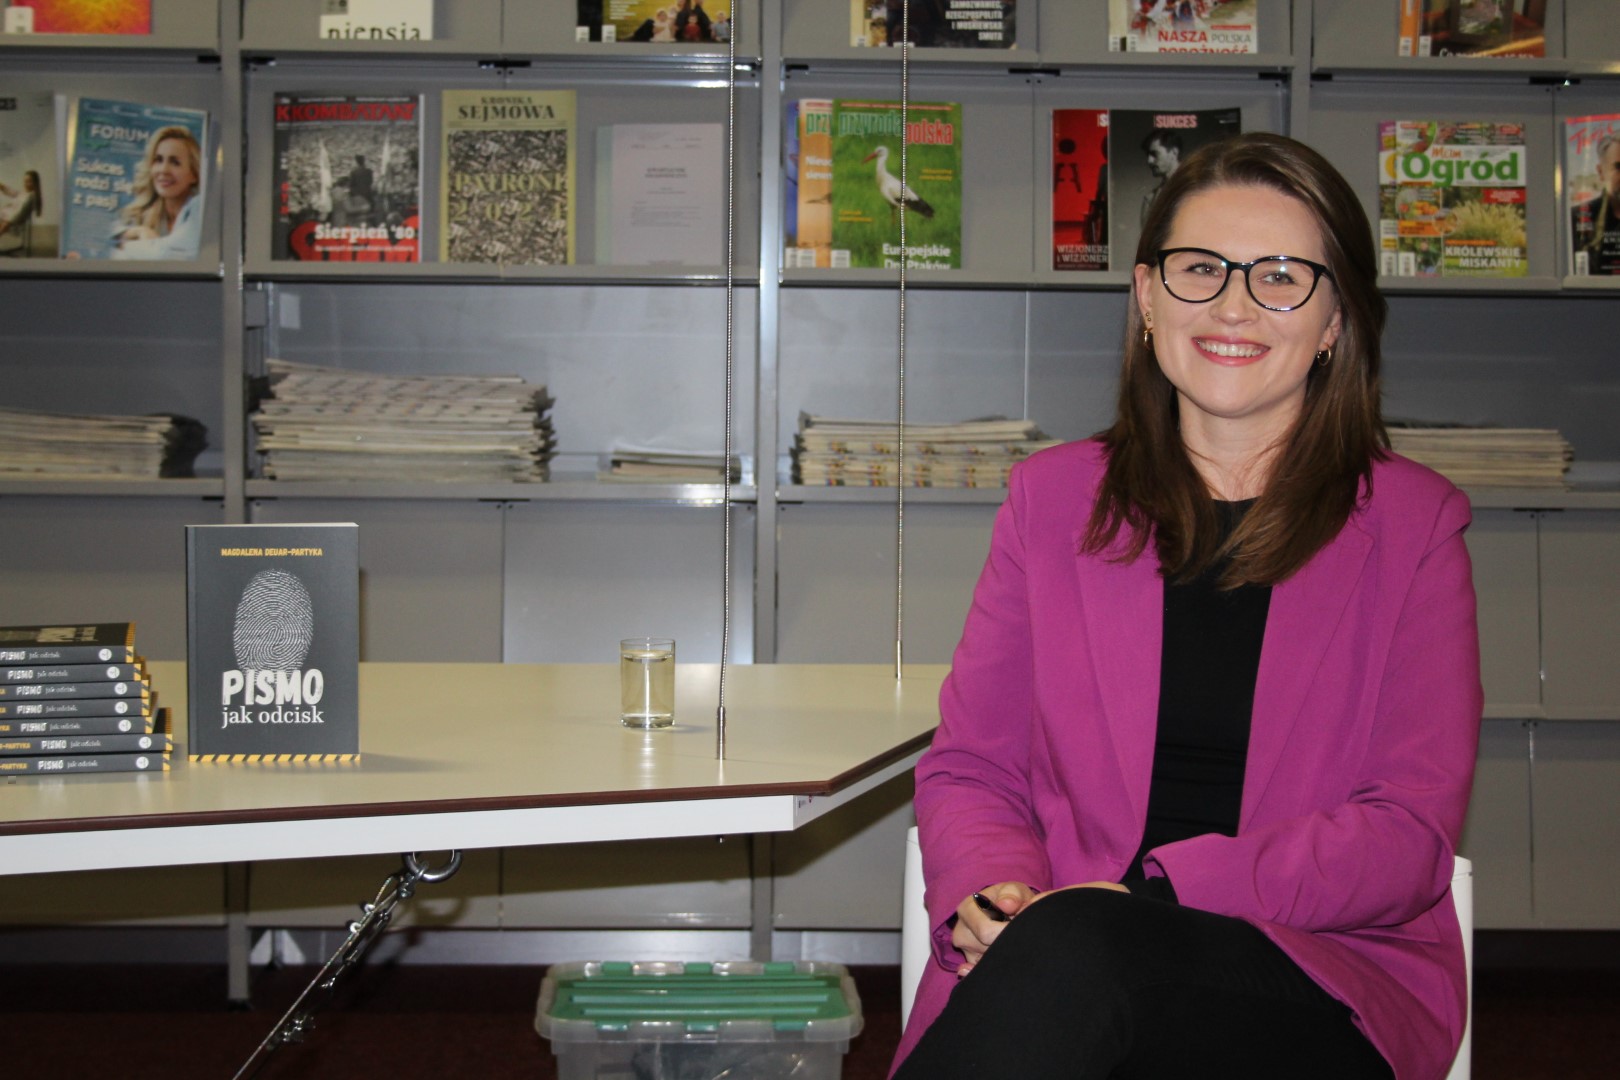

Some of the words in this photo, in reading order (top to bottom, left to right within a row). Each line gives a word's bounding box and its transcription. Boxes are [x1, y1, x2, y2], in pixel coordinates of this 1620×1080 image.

[1158, 31, 1208, 43] NASZA
[1211, 33, 1251, 43] POLSKA
[458, 105, 554, 122] SEJMOWA
[839, 110, 903, 137] przyroda
[1155, 114, 1198, 129] SUKCES
[90, 124, 151, 141] FORUM
[905, 118, 953, 145] polska
[1402, 151, 1519, 188] Ogród
[455, 172, 564, 192] PATRONI
[315, 222, 388, 244] Sierpień
[1445, 245, 1521, 257] KRÓLEWSKIE
[1459, 258, 1521, 268] MISKANTY
[221, 548, 263, 557] MAGDALENA
[0, 651, 26, 660] PISMO
[7, 670, 34, 680] PISMO
[16, 685, 42, 695] PISMO
[222, 668, 324, 706] PISMO
[16, 704, 43, 714] PISMO
[221, 705, 253, 729] jak
[257, 705, 325, 724] odcisk
[20, 723, 47, 732] PISMO
[41, 740, 67, 749] PISMO
[37, 760, 64, 770] PISMO
